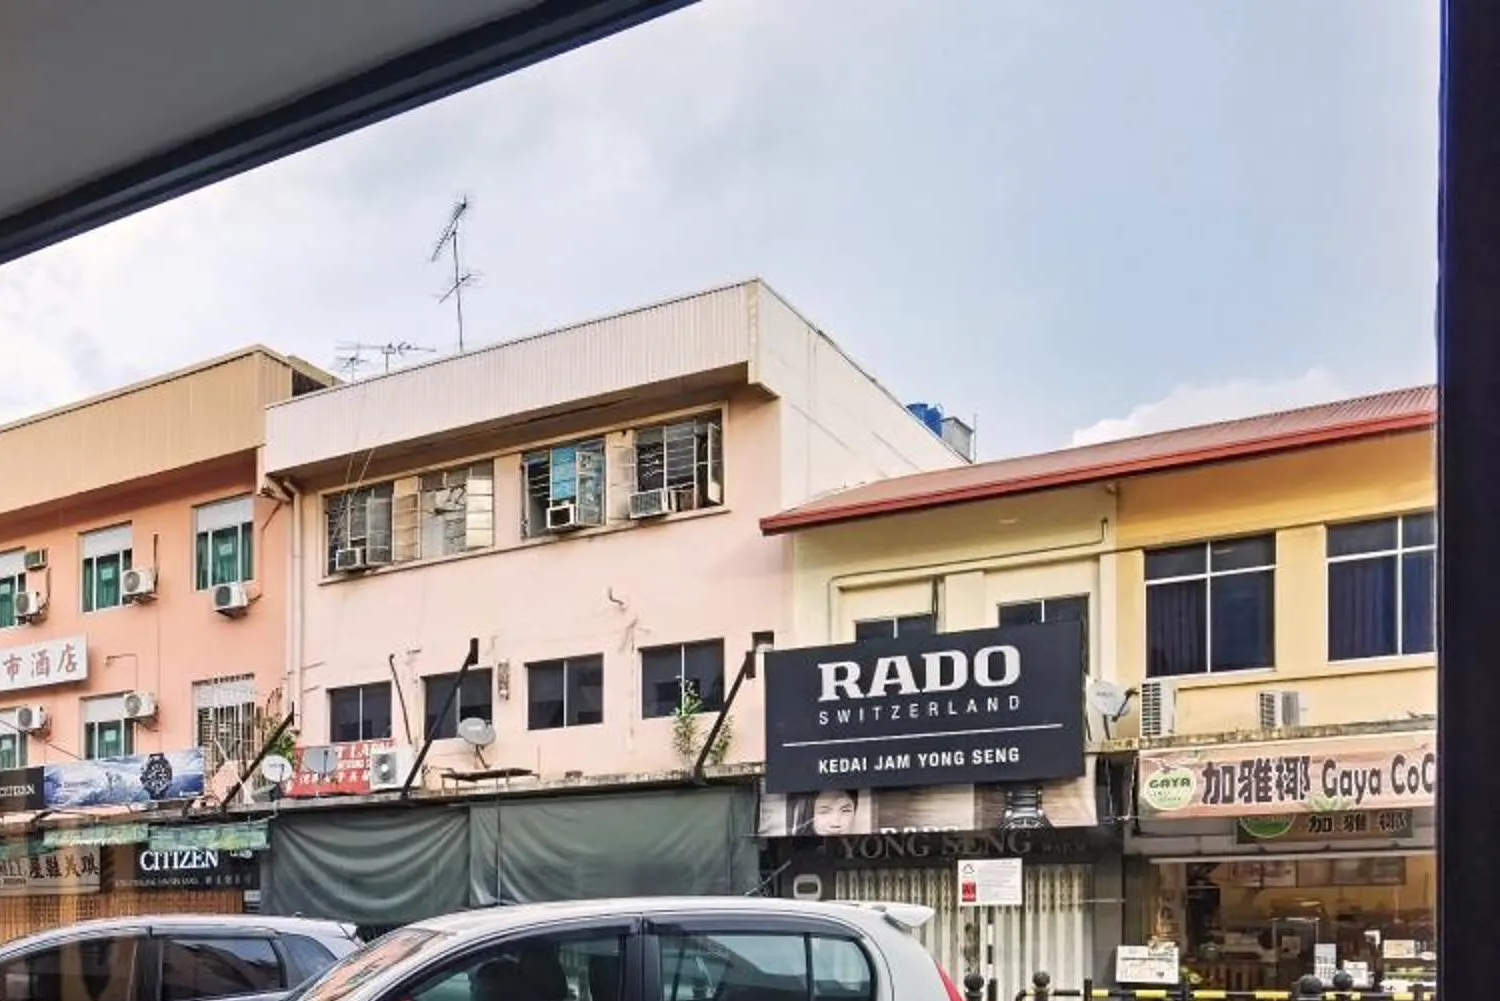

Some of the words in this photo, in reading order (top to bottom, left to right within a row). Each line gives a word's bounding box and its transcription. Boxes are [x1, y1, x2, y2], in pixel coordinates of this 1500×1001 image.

[817, 645, 1021, 702] RADO
[818, 695, 1021, 725] SWITZERLAND
[818, 757, 867, 774] KEDAI
[874, 754, 910, 771] JAM
[918, 751, 965, 767] YONG
[973, 748, 1020, 765] SENG
[1149, 777, 1191, 788] GAYA
[1322, 759, 1382, 805] Gaya
[139, 850, 219, 871] CITIZEN
